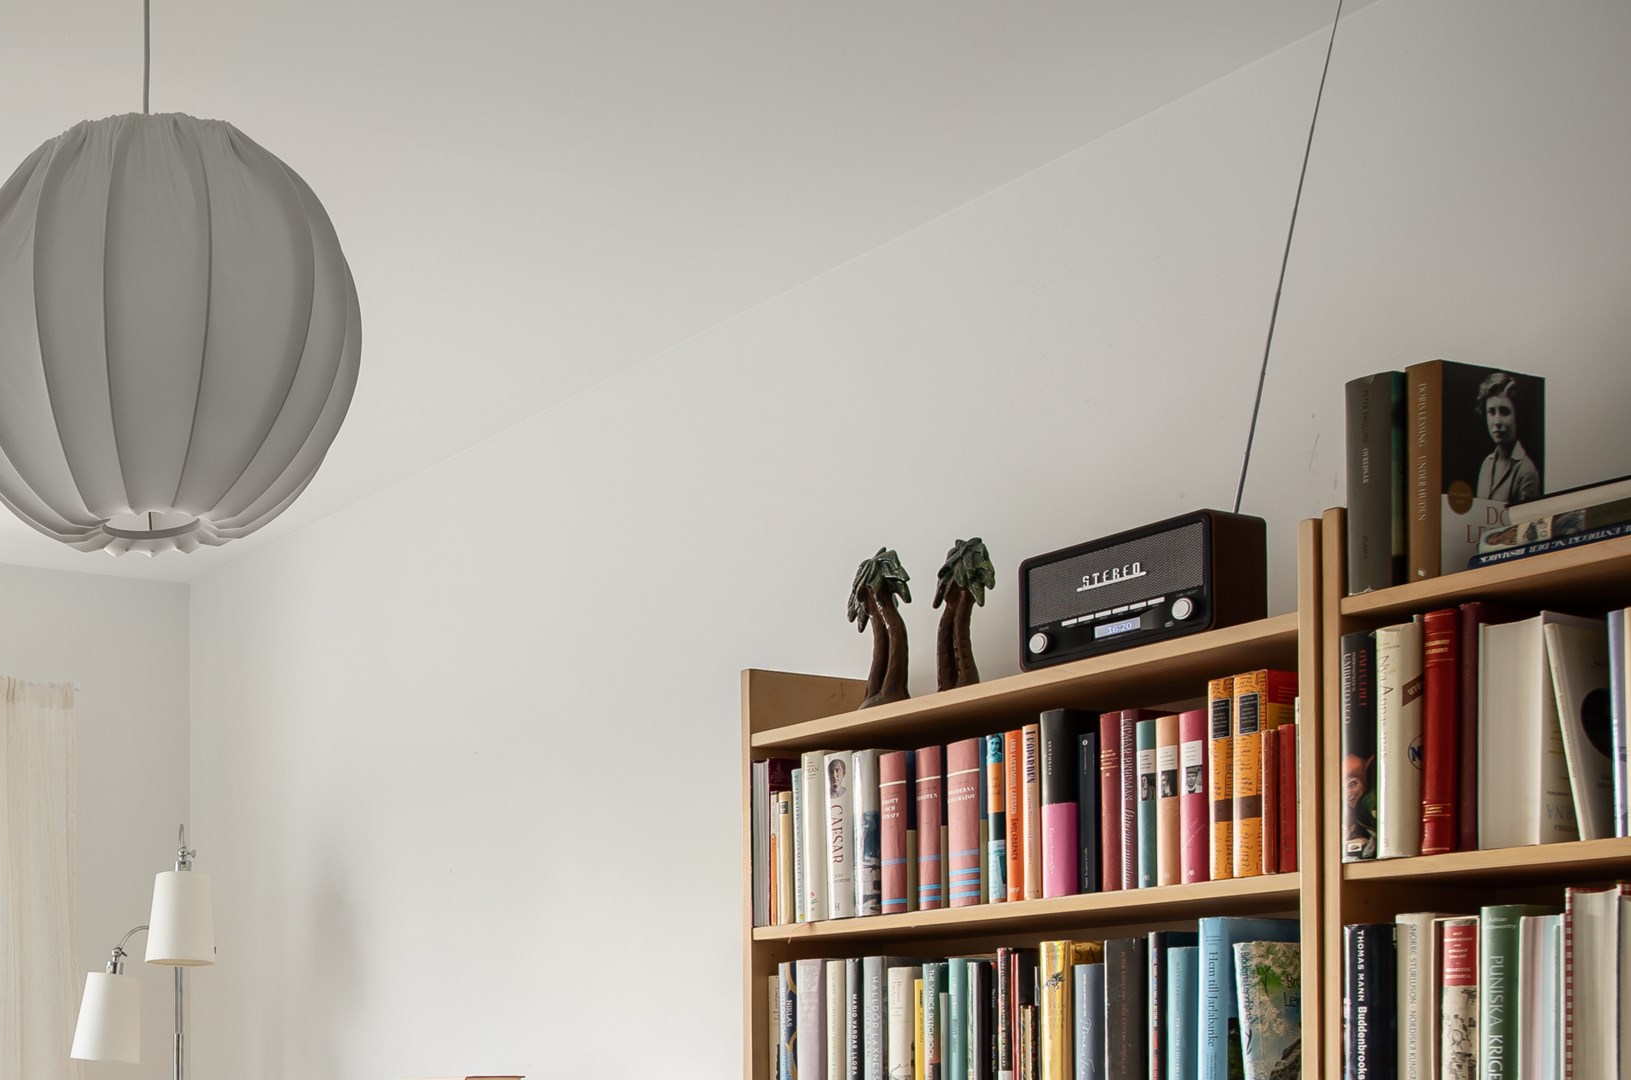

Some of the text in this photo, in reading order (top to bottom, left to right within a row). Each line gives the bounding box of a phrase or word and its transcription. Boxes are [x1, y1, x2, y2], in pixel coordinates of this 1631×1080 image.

[1418, 383, 1427, 521] DORIS LESSING UNDER HUDEN
[1082, 562, 1141, 588] STEREO
[1107, 621, 1133, 635] 16:20
[1343, 653, 1352, 724] UMBERTO ECO
[1026, 730, 1036, 784] LEOPARDEN
[830, 804, 845, 865] CAESAR
[1208, 951, 1219, 978] Hem
[1208, 980, 1219, 993] till
[1489, 955, 1504, 1027] PUNISKA
[872, 975, 880, 1080] HALLDÓR LAXNESS
[1205, 995, 1219, 1048] Jarlabanke
[1357, 930, 1368, 1080] THOMAS MANN Buddenbrooks
